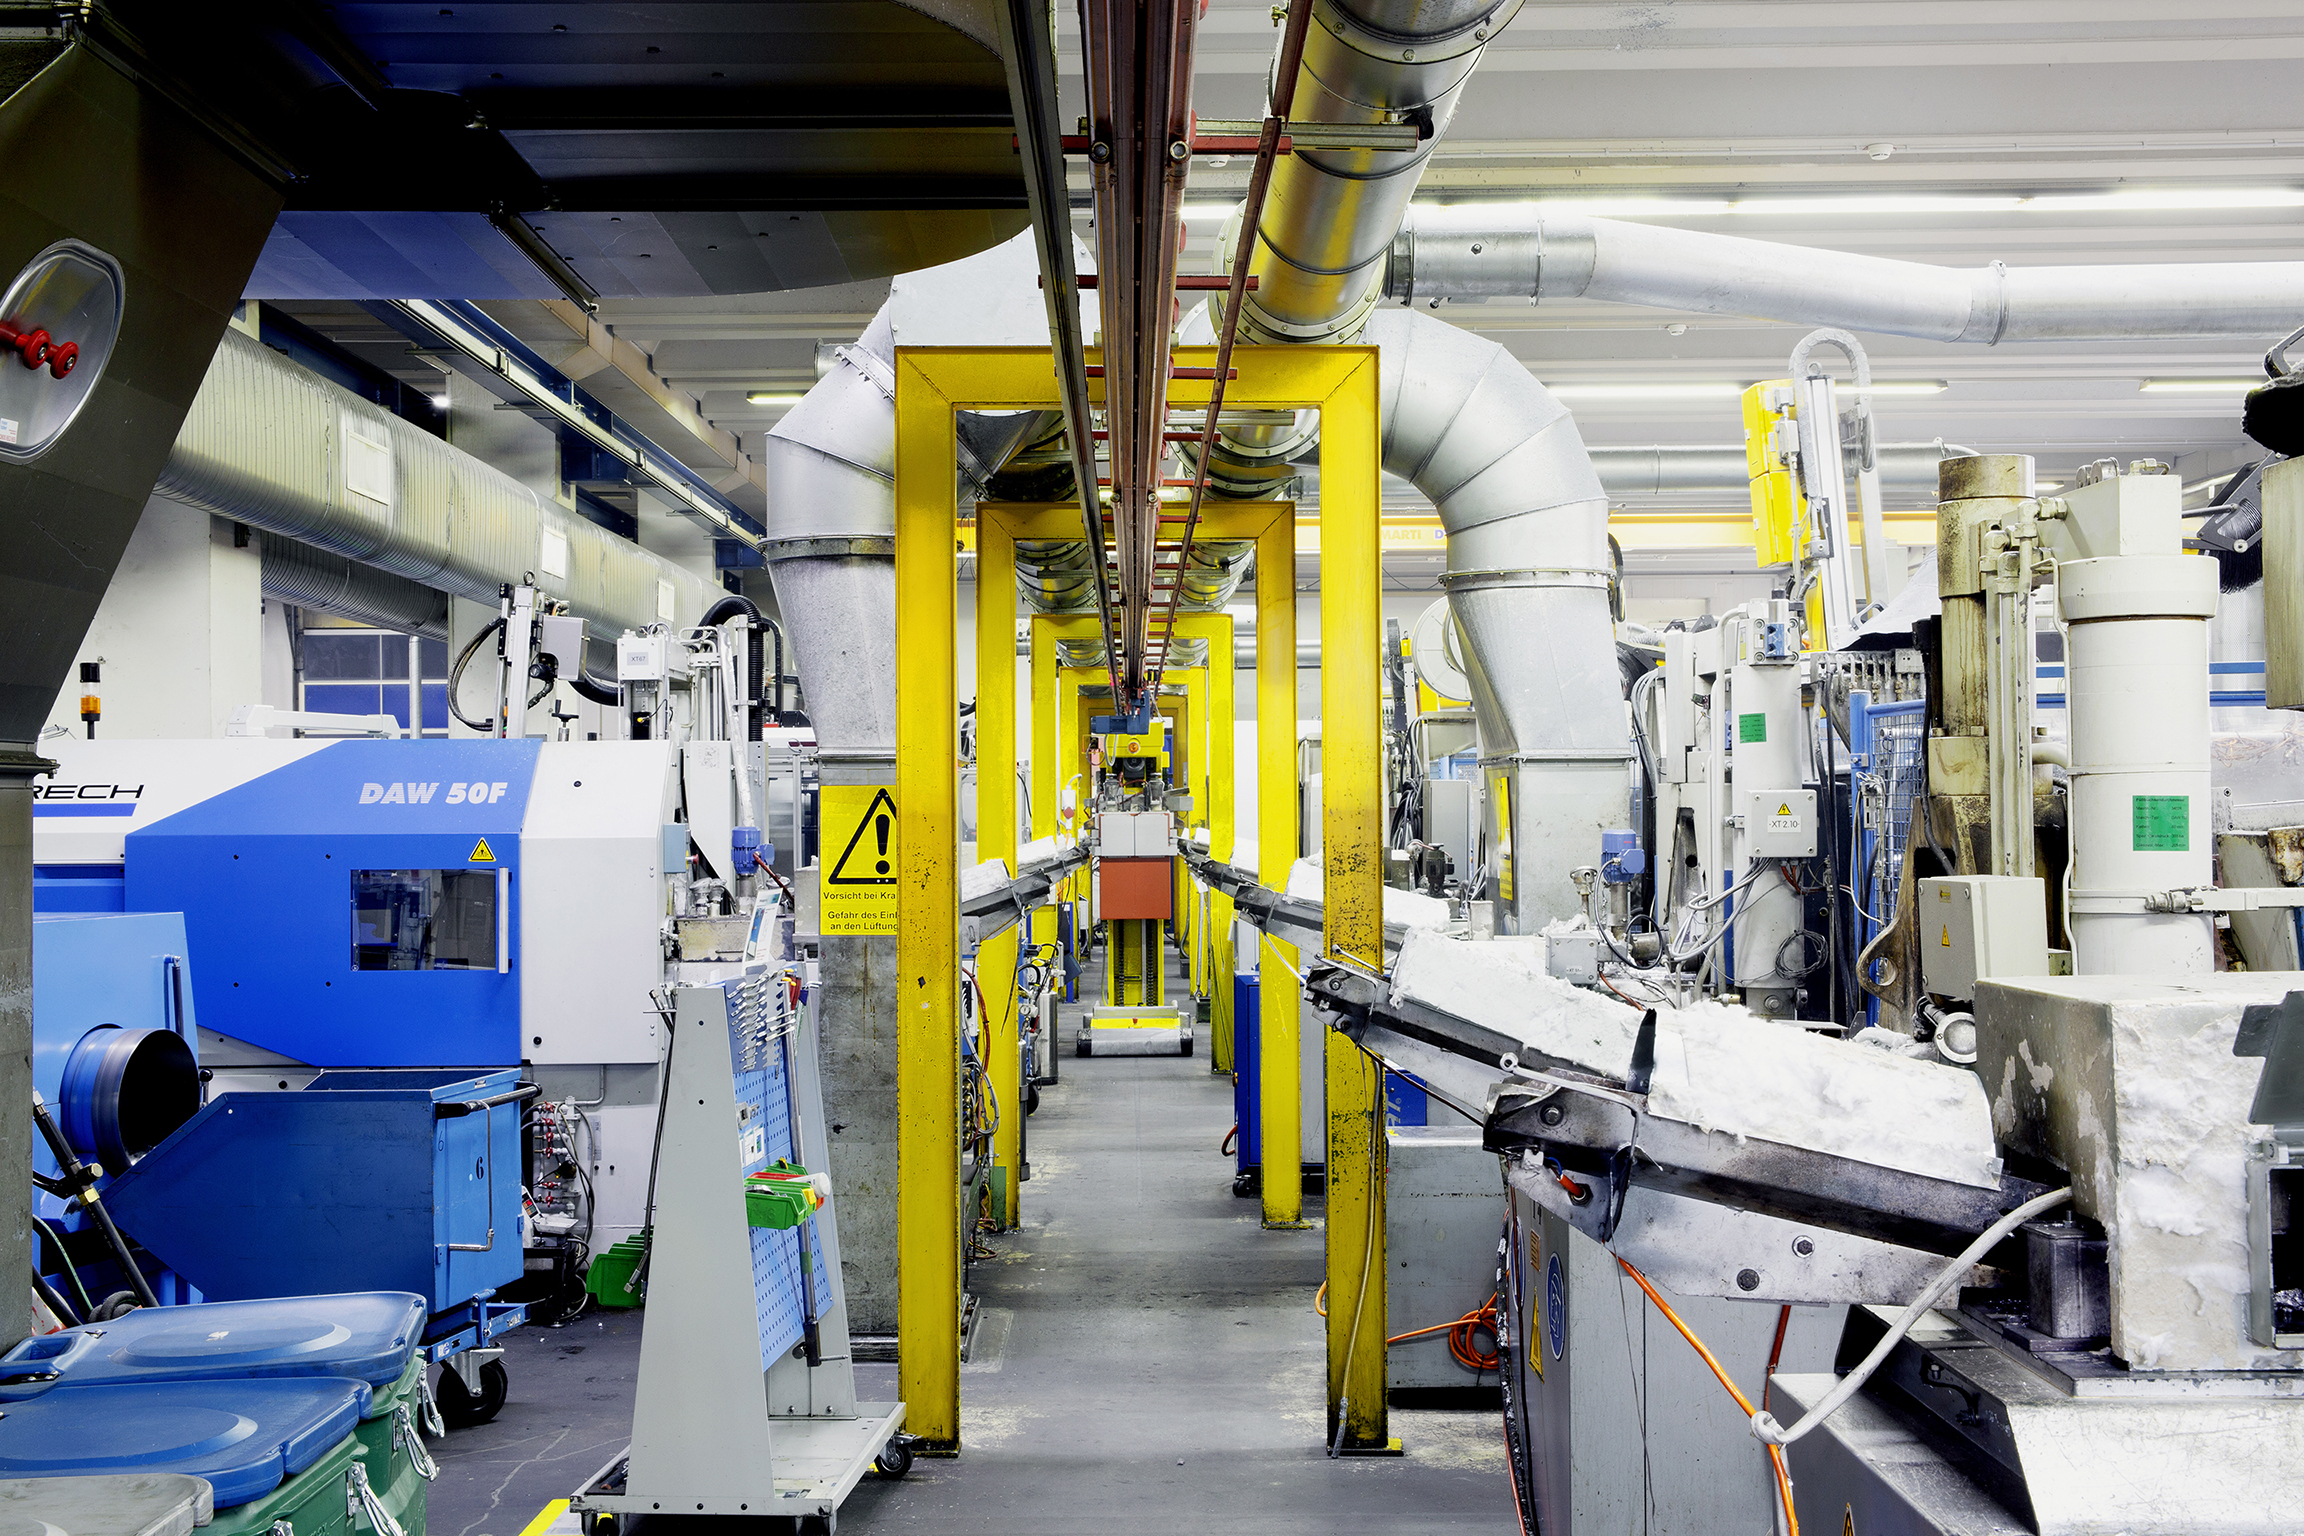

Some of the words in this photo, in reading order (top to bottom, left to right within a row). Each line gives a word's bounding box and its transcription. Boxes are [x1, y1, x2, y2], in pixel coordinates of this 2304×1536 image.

[33, 784, 145, 800] RECH
[358, 782, 440, 804] DAW
[445, 782, 508, 805] 50F
[828, 911, 858, 919] Gefahr
[861, 911, 878, 919] des
[864, 922, 898, 932] Lüftung
[476, 1156, 484, 1180] 6
